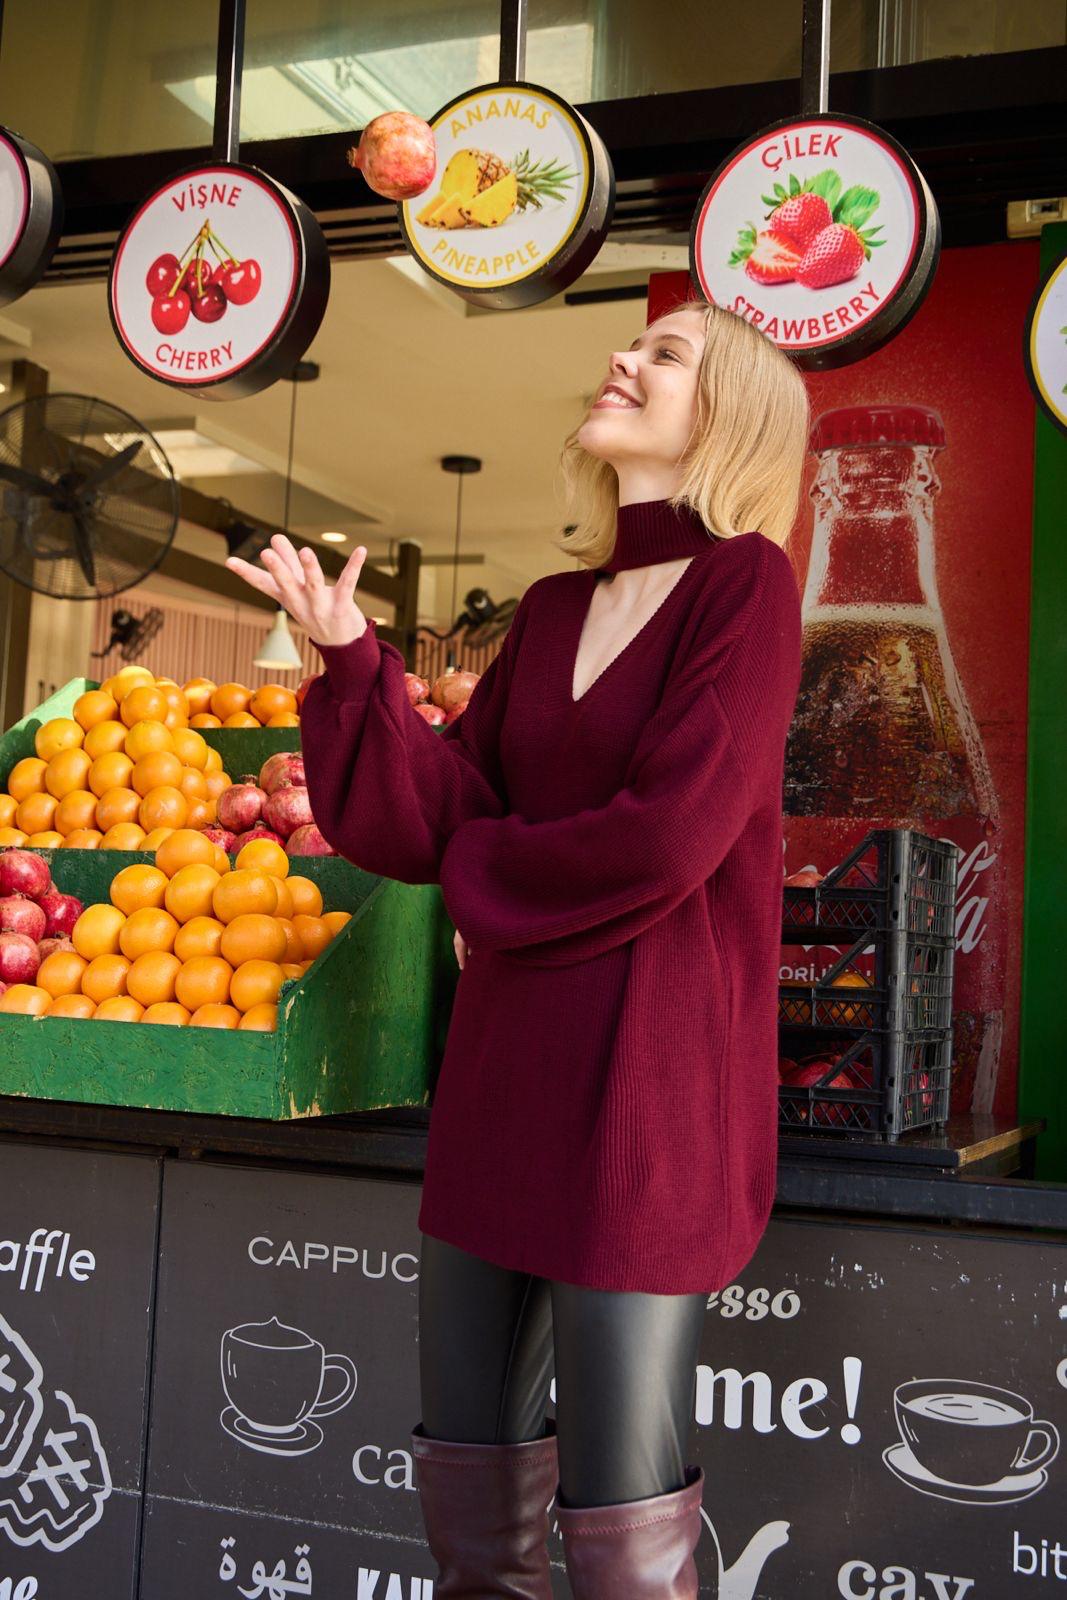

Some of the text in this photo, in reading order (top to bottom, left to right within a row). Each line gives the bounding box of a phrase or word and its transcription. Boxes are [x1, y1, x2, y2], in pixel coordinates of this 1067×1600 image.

[450, 98, 551, 139] ANANAS
[761, 133, 843, 172] ÇİLEK
[171, 183, 242, 213] VİŞNE
[431, 238, 541, 276] PINEAPPLE
[155, 340, 234, 371] CHERRY
